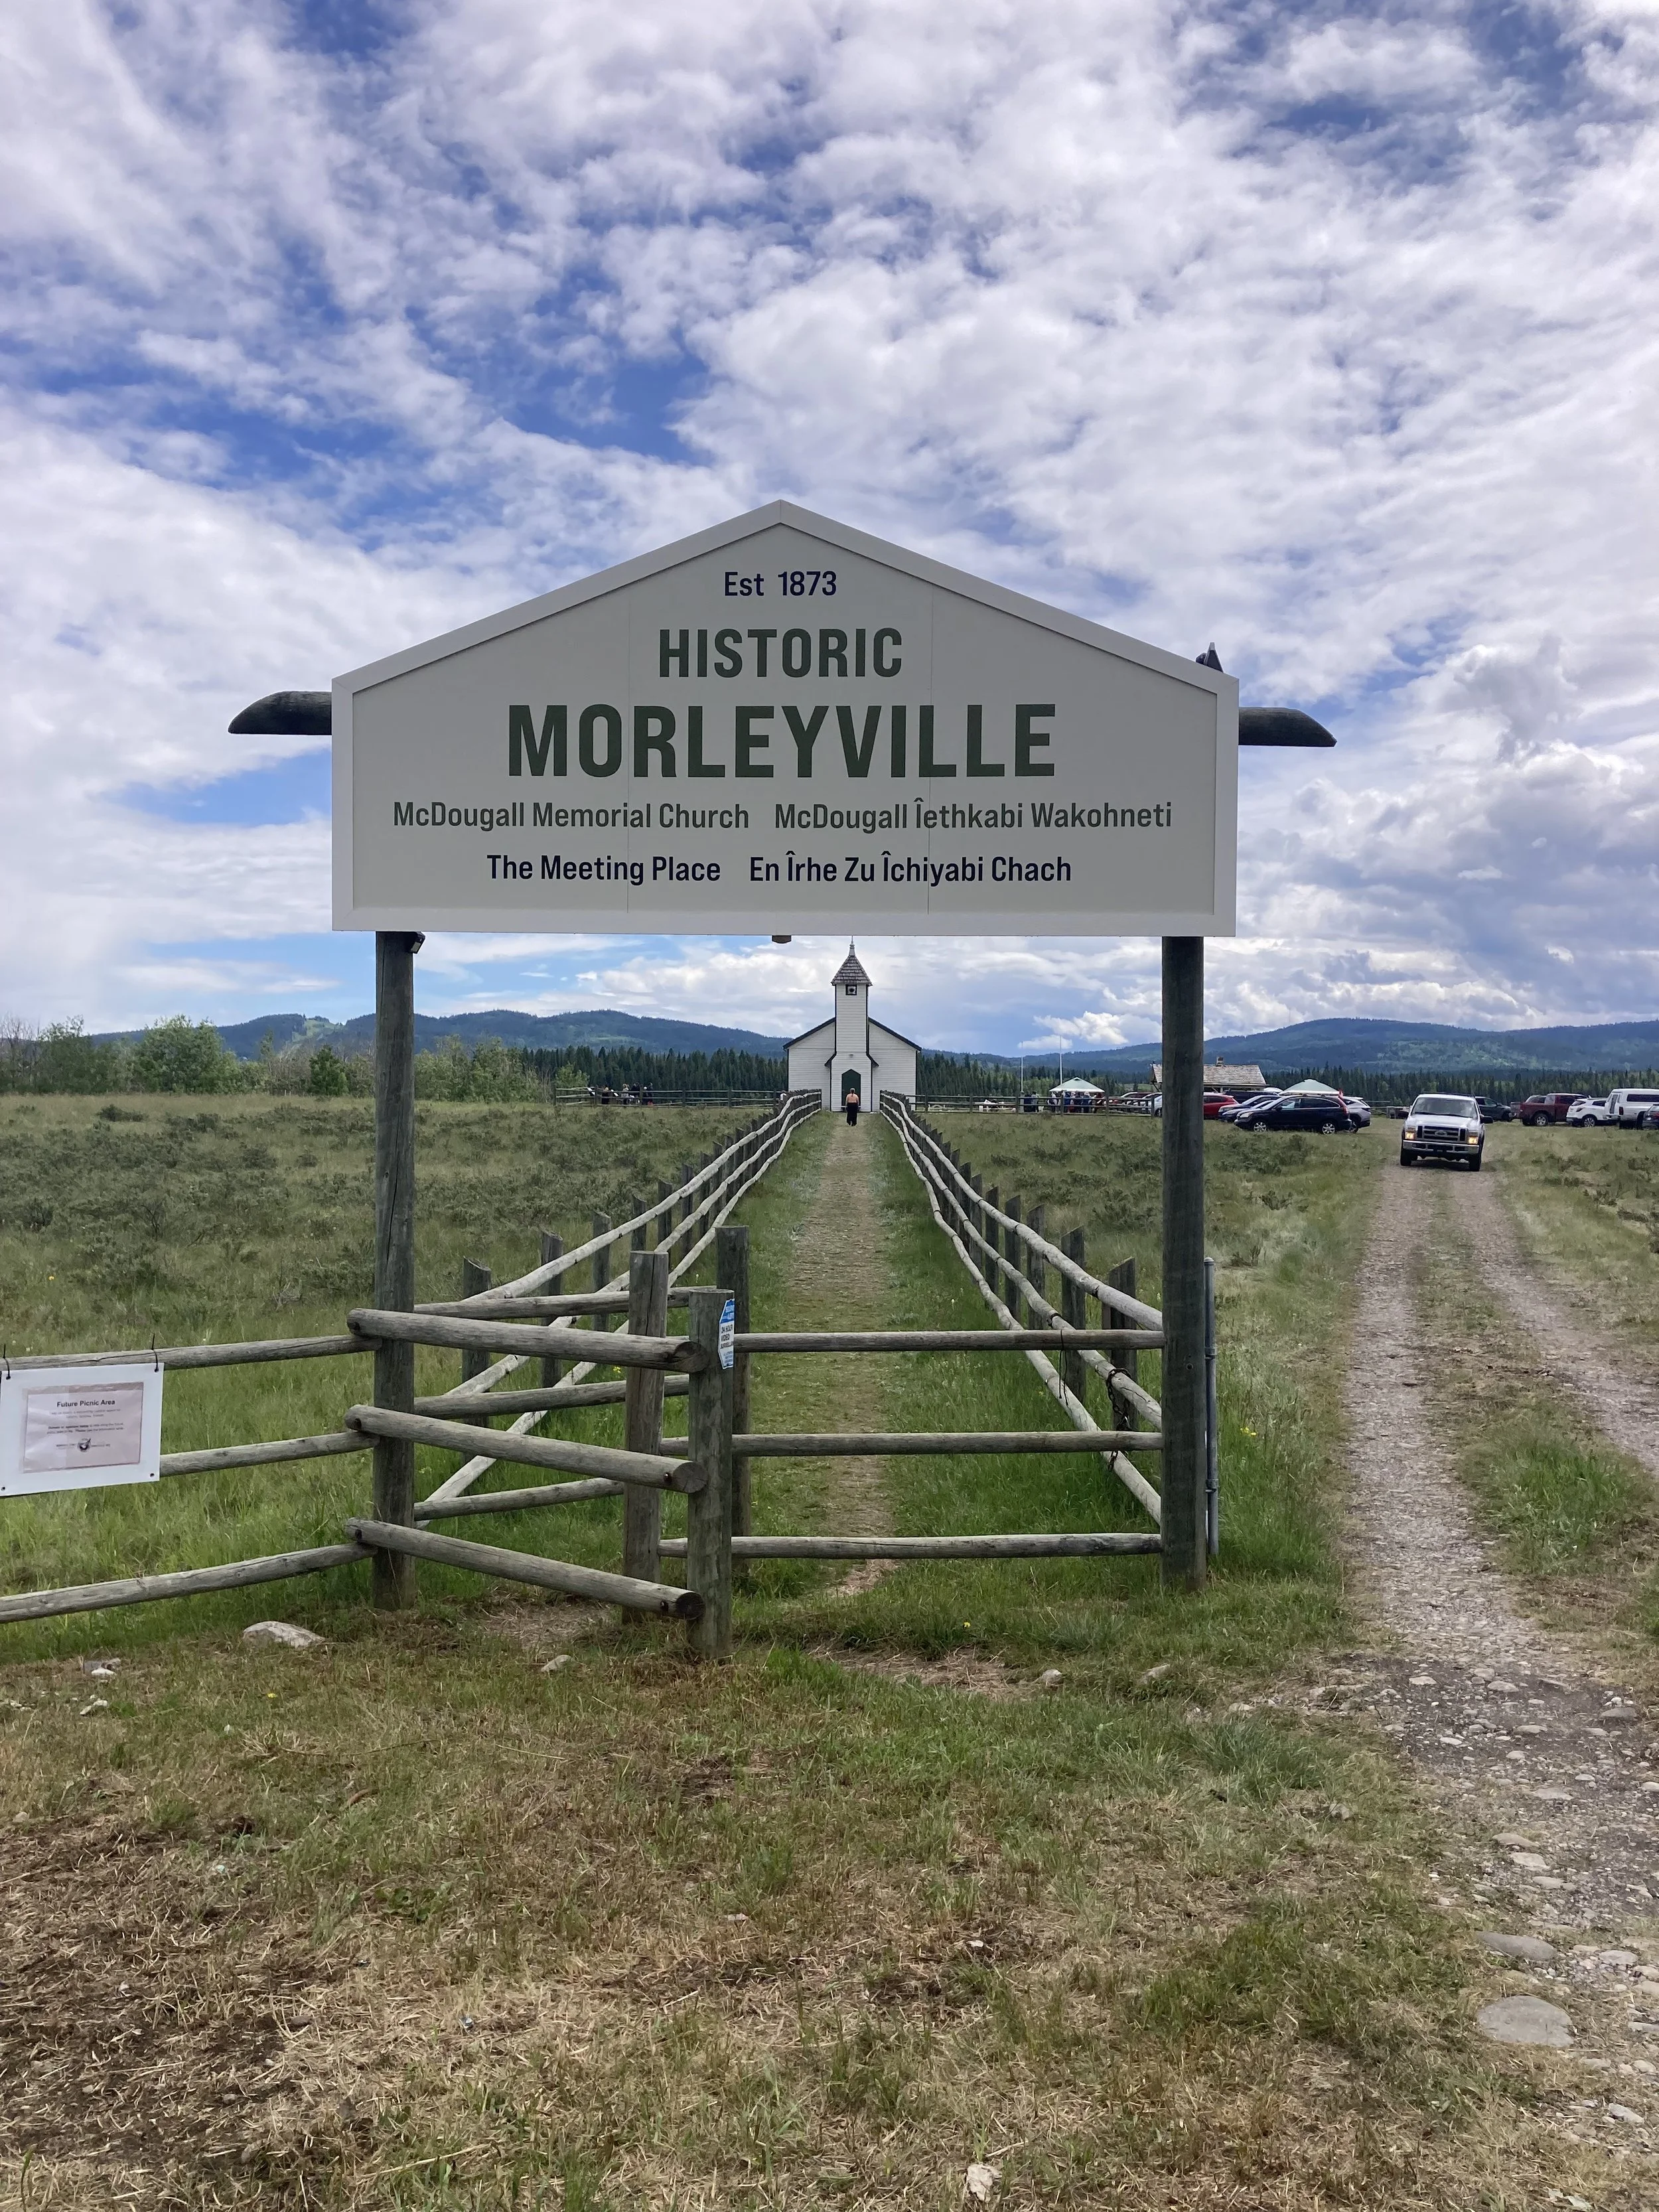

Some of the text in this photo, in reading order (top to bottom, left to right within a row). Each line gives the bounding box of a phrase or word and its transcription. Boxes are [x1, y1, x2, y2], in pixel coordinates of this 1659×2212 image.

[724, 571, 837, 597] Est 1873
[658, 627, 902, 679] HISTORIC
[508, 703, 1056, 778] MORLEYVILLE
[394, 801, 749, 832] McDougall Memorial Church
[775, 797, 1172, 834] McDougall Îethkabi Wakohneti
[486, 854, 721, 886] The Meeting Place
[751, 850, 1071, 887] En Îrhe Zu Îchiyabi Chach
